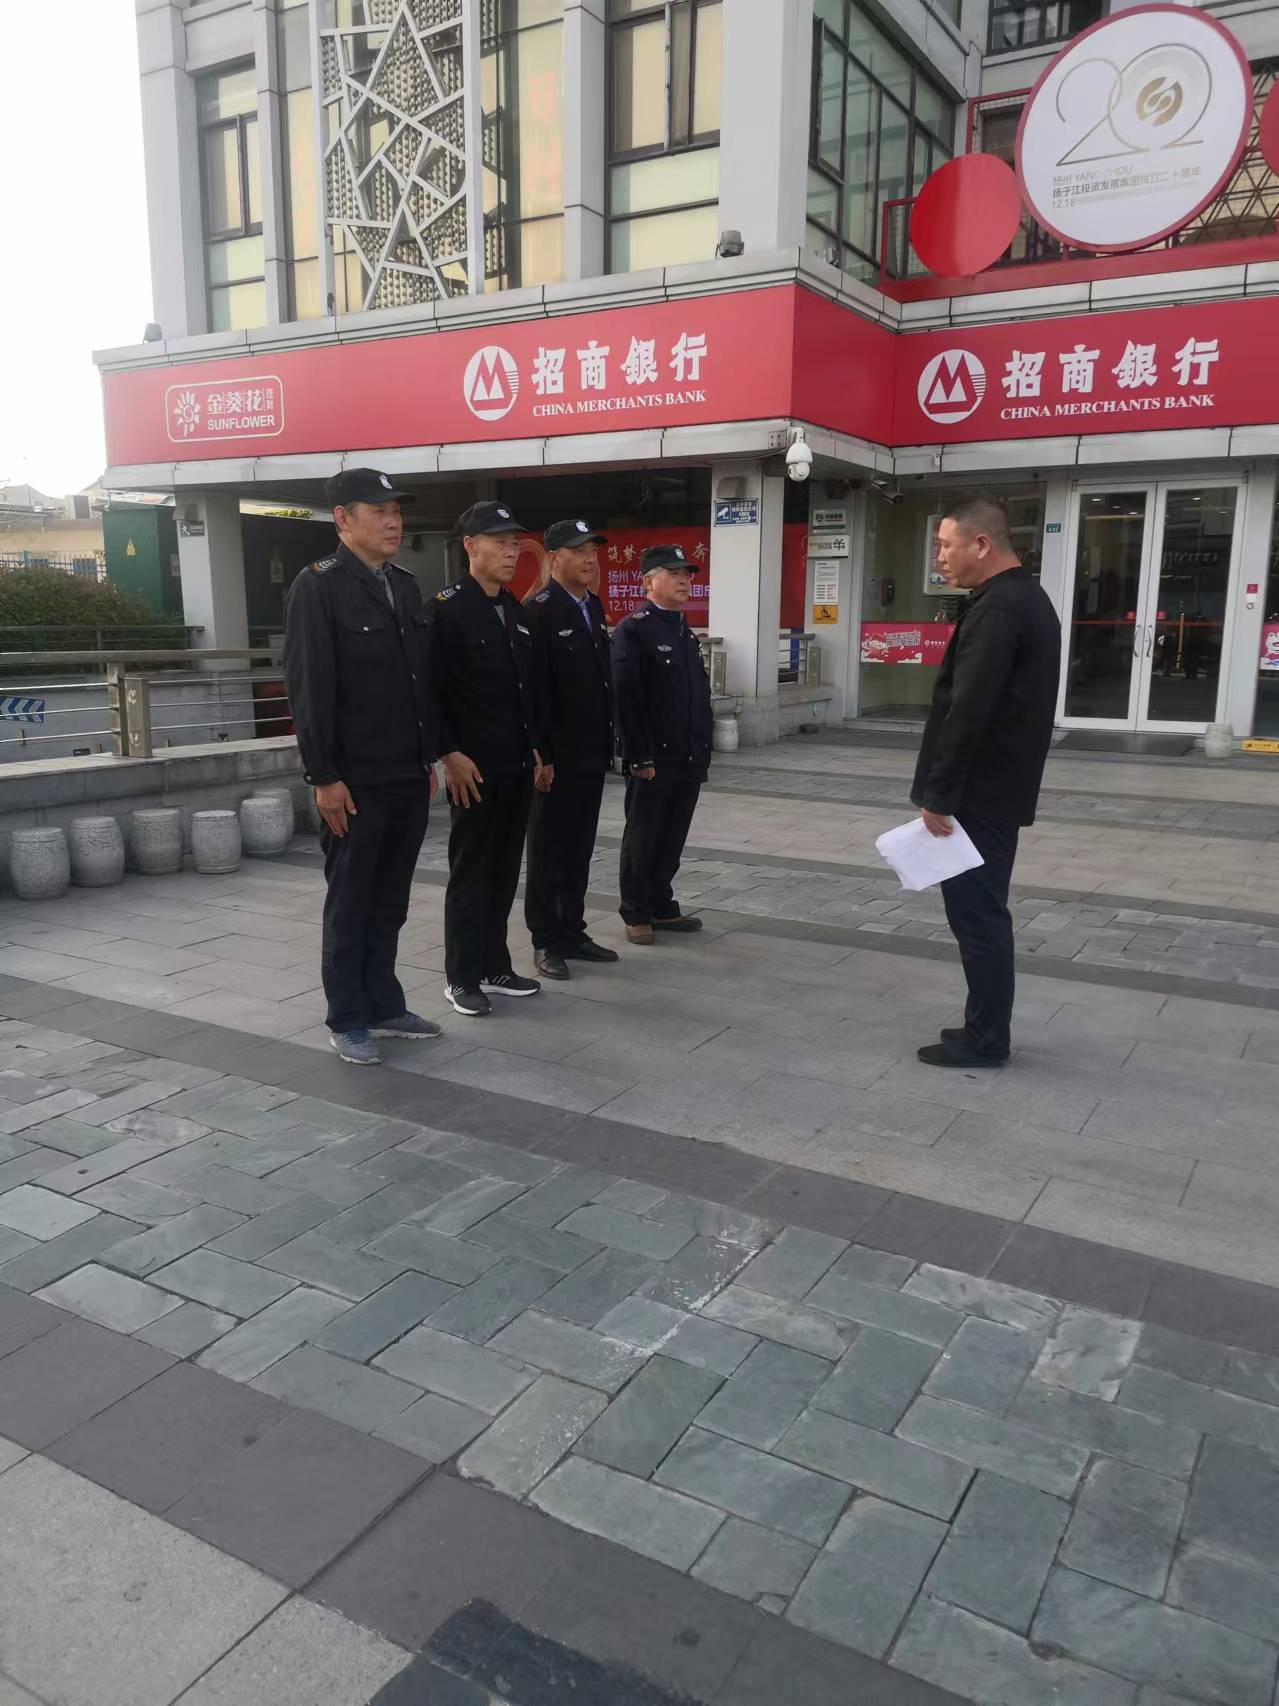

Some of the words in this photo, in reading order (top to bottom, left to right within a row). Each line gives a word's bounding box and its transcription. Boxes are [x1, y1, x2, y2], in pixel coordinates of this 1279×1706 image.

[208, 389, 263, 413] 金葵花
[532, 402, 574, 417] CHINA
[577, 393, 662, 413] MERCHANTS
[665, 389, 707, 404] BANK
[1000, 406, 1051, 421] CHINA
[1055, 397, 1160, 416] MERCHANTS
[1164, 393, 1214, 409] BANK
[208, 415, 275, 431] SUNFLOWER
[608, 569, 629, 583] 扬州
[609, 600, 635, 611] 12.18
